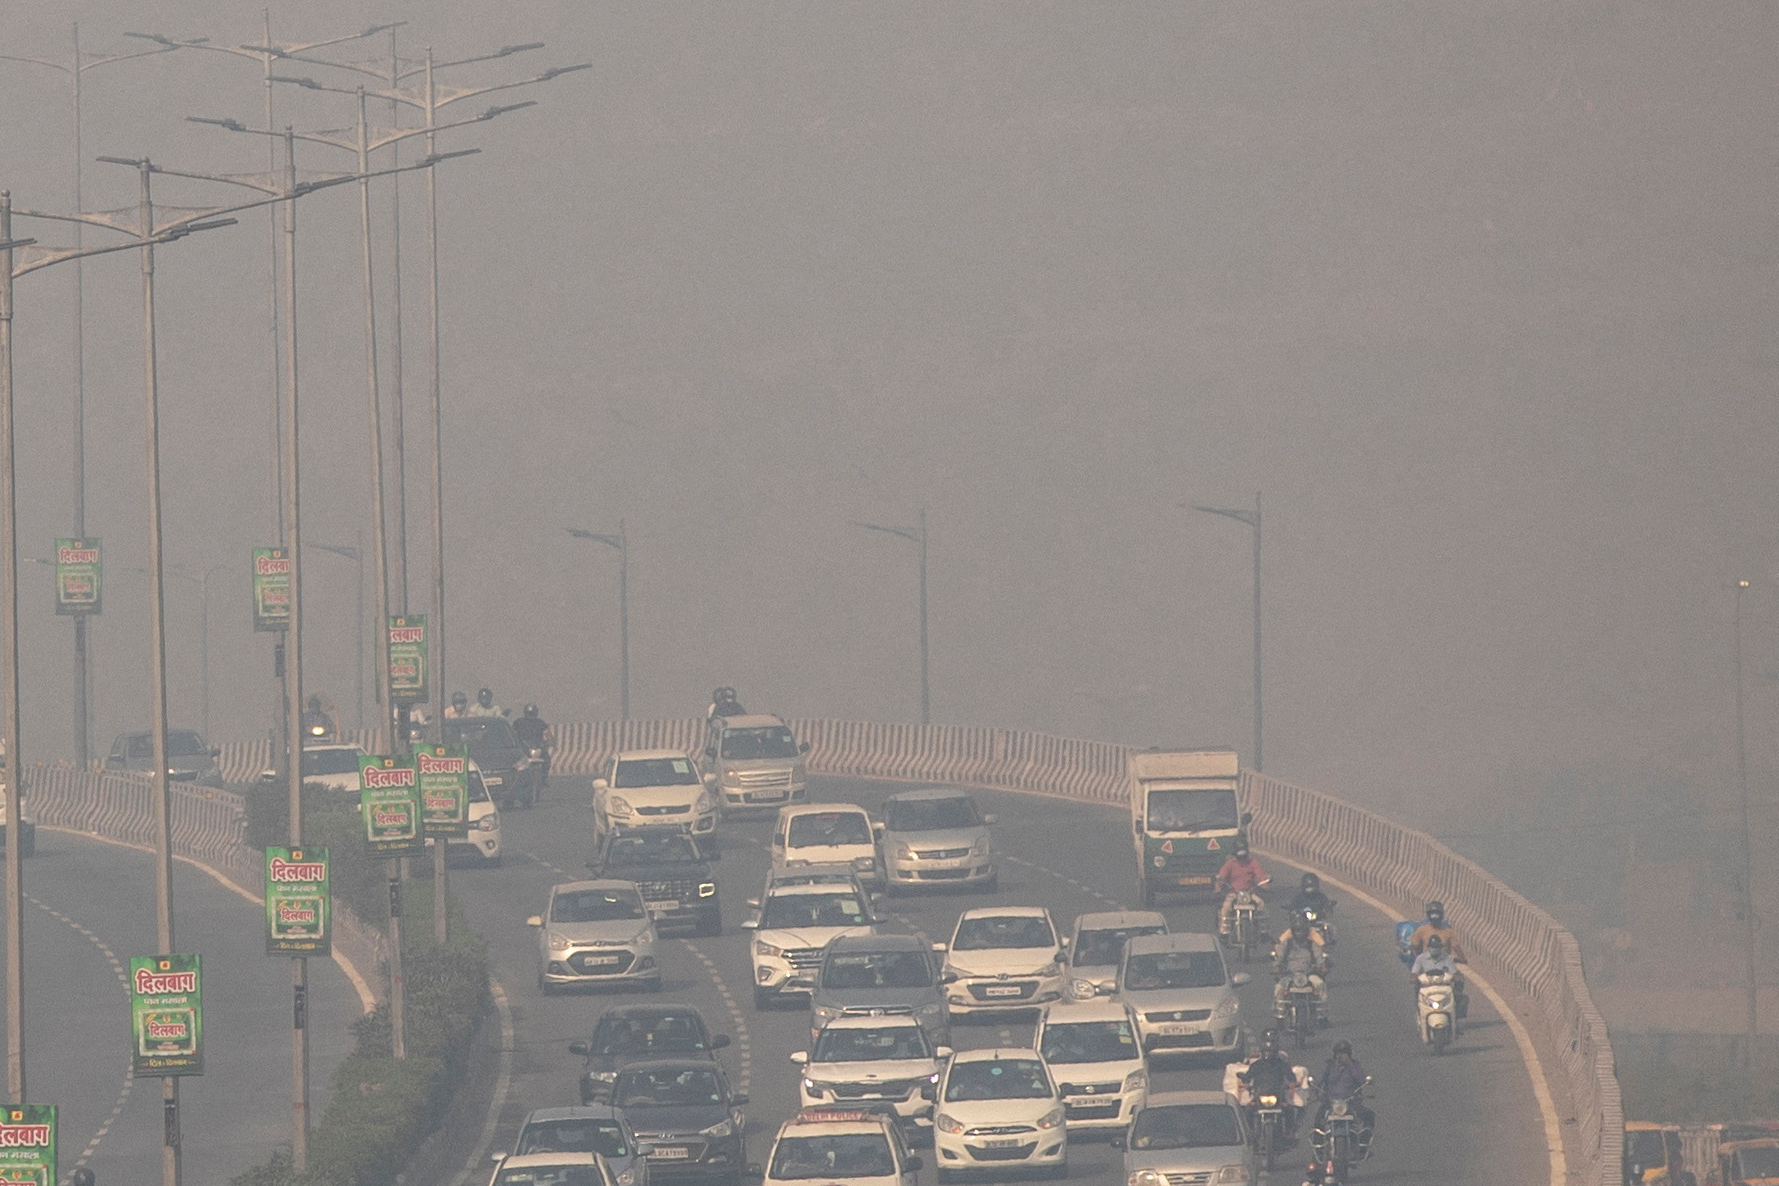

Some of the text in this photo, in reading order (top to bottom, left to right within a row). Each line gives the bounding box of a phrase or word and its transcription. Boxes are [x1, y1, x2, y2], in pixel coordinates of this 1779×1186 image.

[256, 555, 290, 575] दिलबा
[390, 627, 423, 643] लबाग
[363, 765, 415, 789] दिलबाग
[270, 857, 325, 882] दिलबाग
[135, 967, 196, 995] दिलबाग
[149, 1021, 186, 1037] दिलबाग
